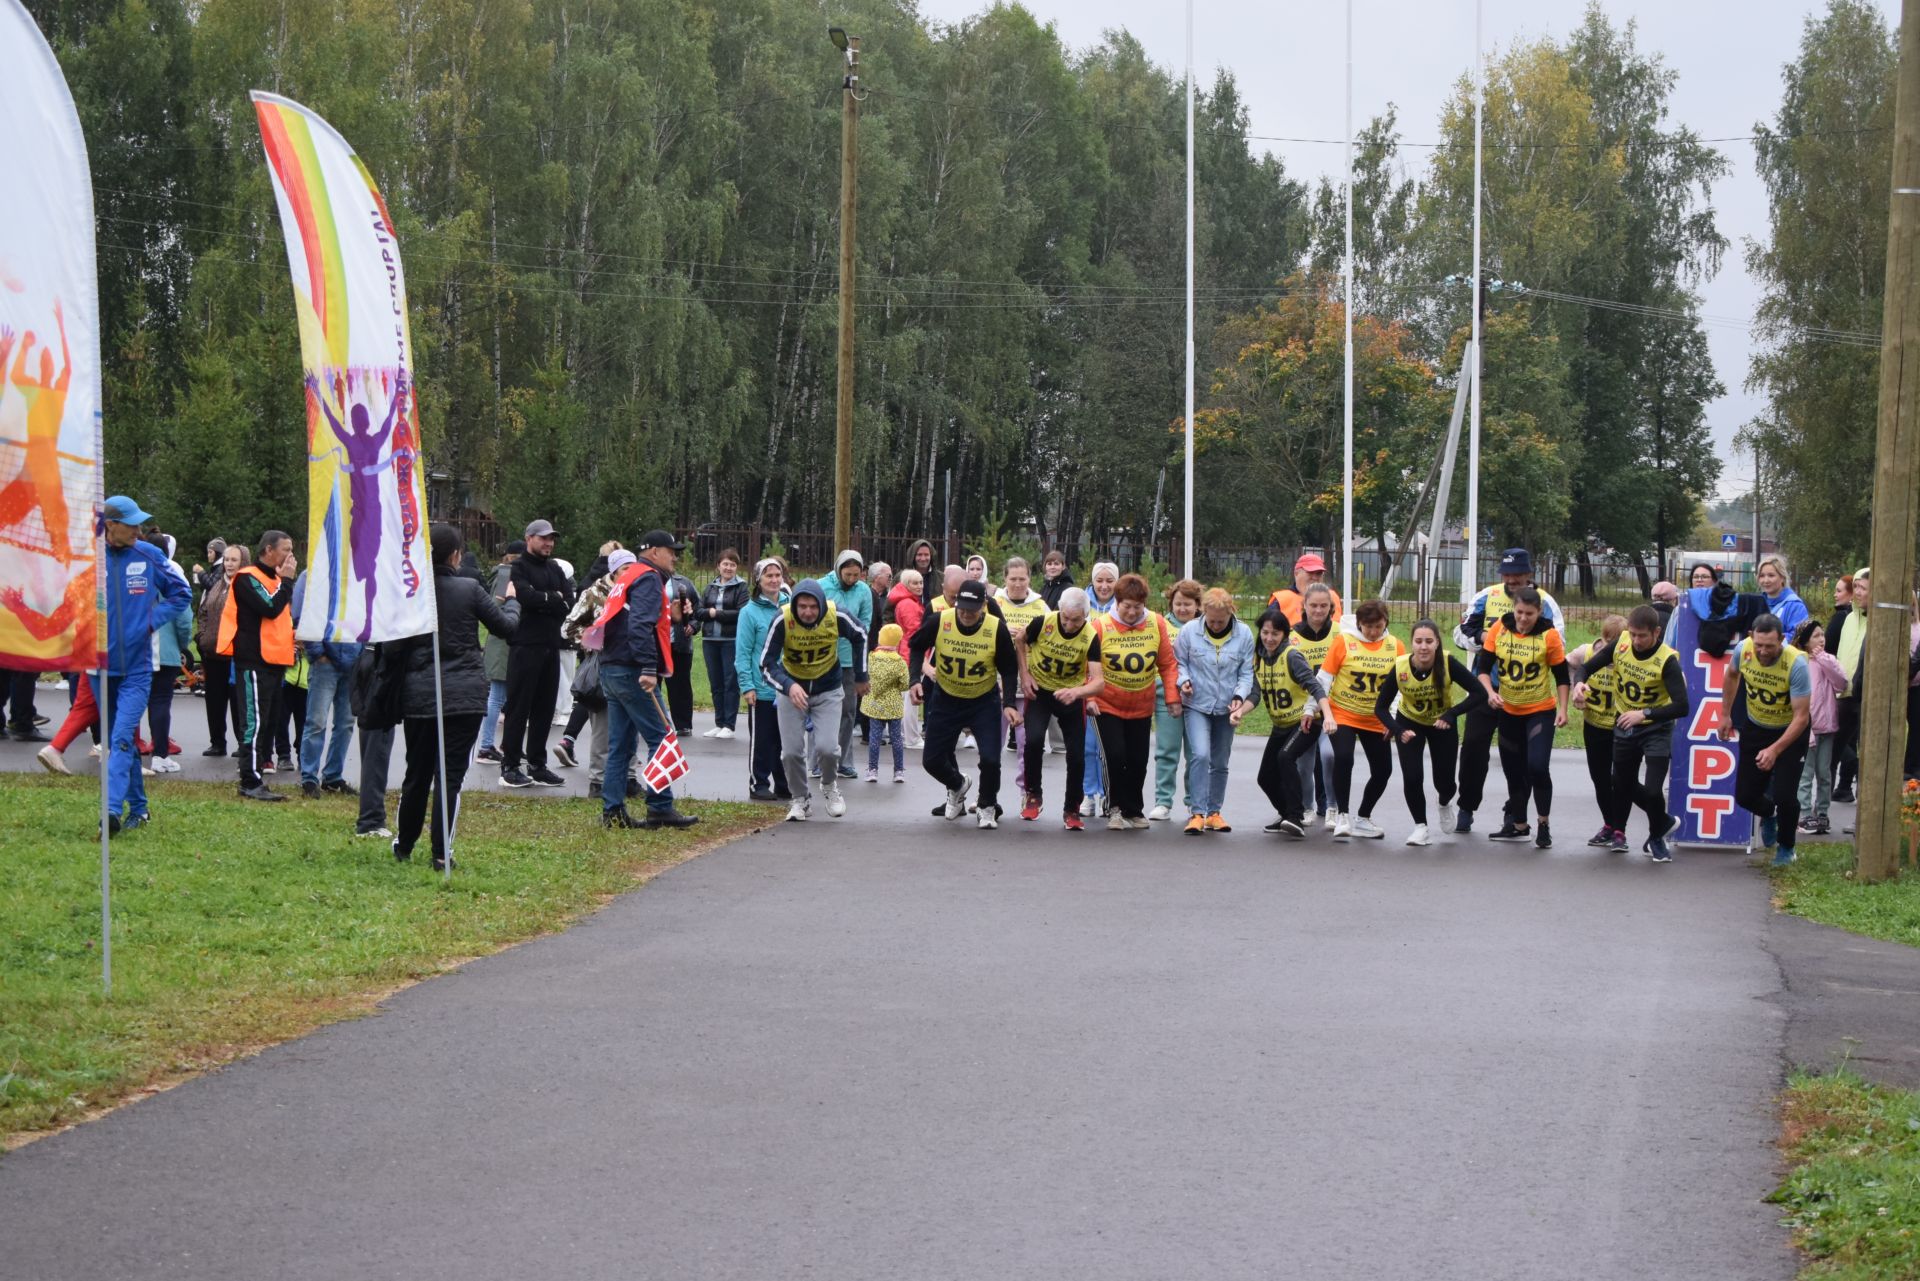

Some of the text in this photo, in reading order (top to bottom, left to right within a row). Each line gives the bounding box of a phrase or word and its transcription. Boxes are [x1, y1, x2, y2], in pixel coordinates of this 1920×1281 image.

[944, 638, 989, 651] ТУКАЕВСКИЙ
[1110, 634, 1154, 643] ТУКАЕВСКИЙ
[787, 644, 832, 664] 315
[952, 646, 978, 656] РАЙОН
[1044, 640, 1084, 655] ТУКАЕВСКИЙ
[1050, 649, 1075, 659] РАЙОН
[1500, 642, 1540, 653] ТУКАЕВСКИЙ
[1506, 649, 1529, 657] РАЙОН
[940, 653, 988, 679] 314
[1037, 651, 1082, 677] 313
[1105, 651, 1158, 674] 302
[1353, 655, 1395, 664] ТУКАЕВСКИЙ
[1498, 659, 1540, 682] 309
[1616, 659, 1657, 678] ТУКАЕВСКИЙ
[1623, 669, 1646, 682] РАЙОН
[1746, 667, 1786, 683] ТУКАЕВСКИЙ
[1614, 670, 1660, 704] 305
[1753, 676, 1778, 687] РАЙОН
[1585, 686, 1613, 710] 31
[1686, 645, 1741, 839] ТАРТ
